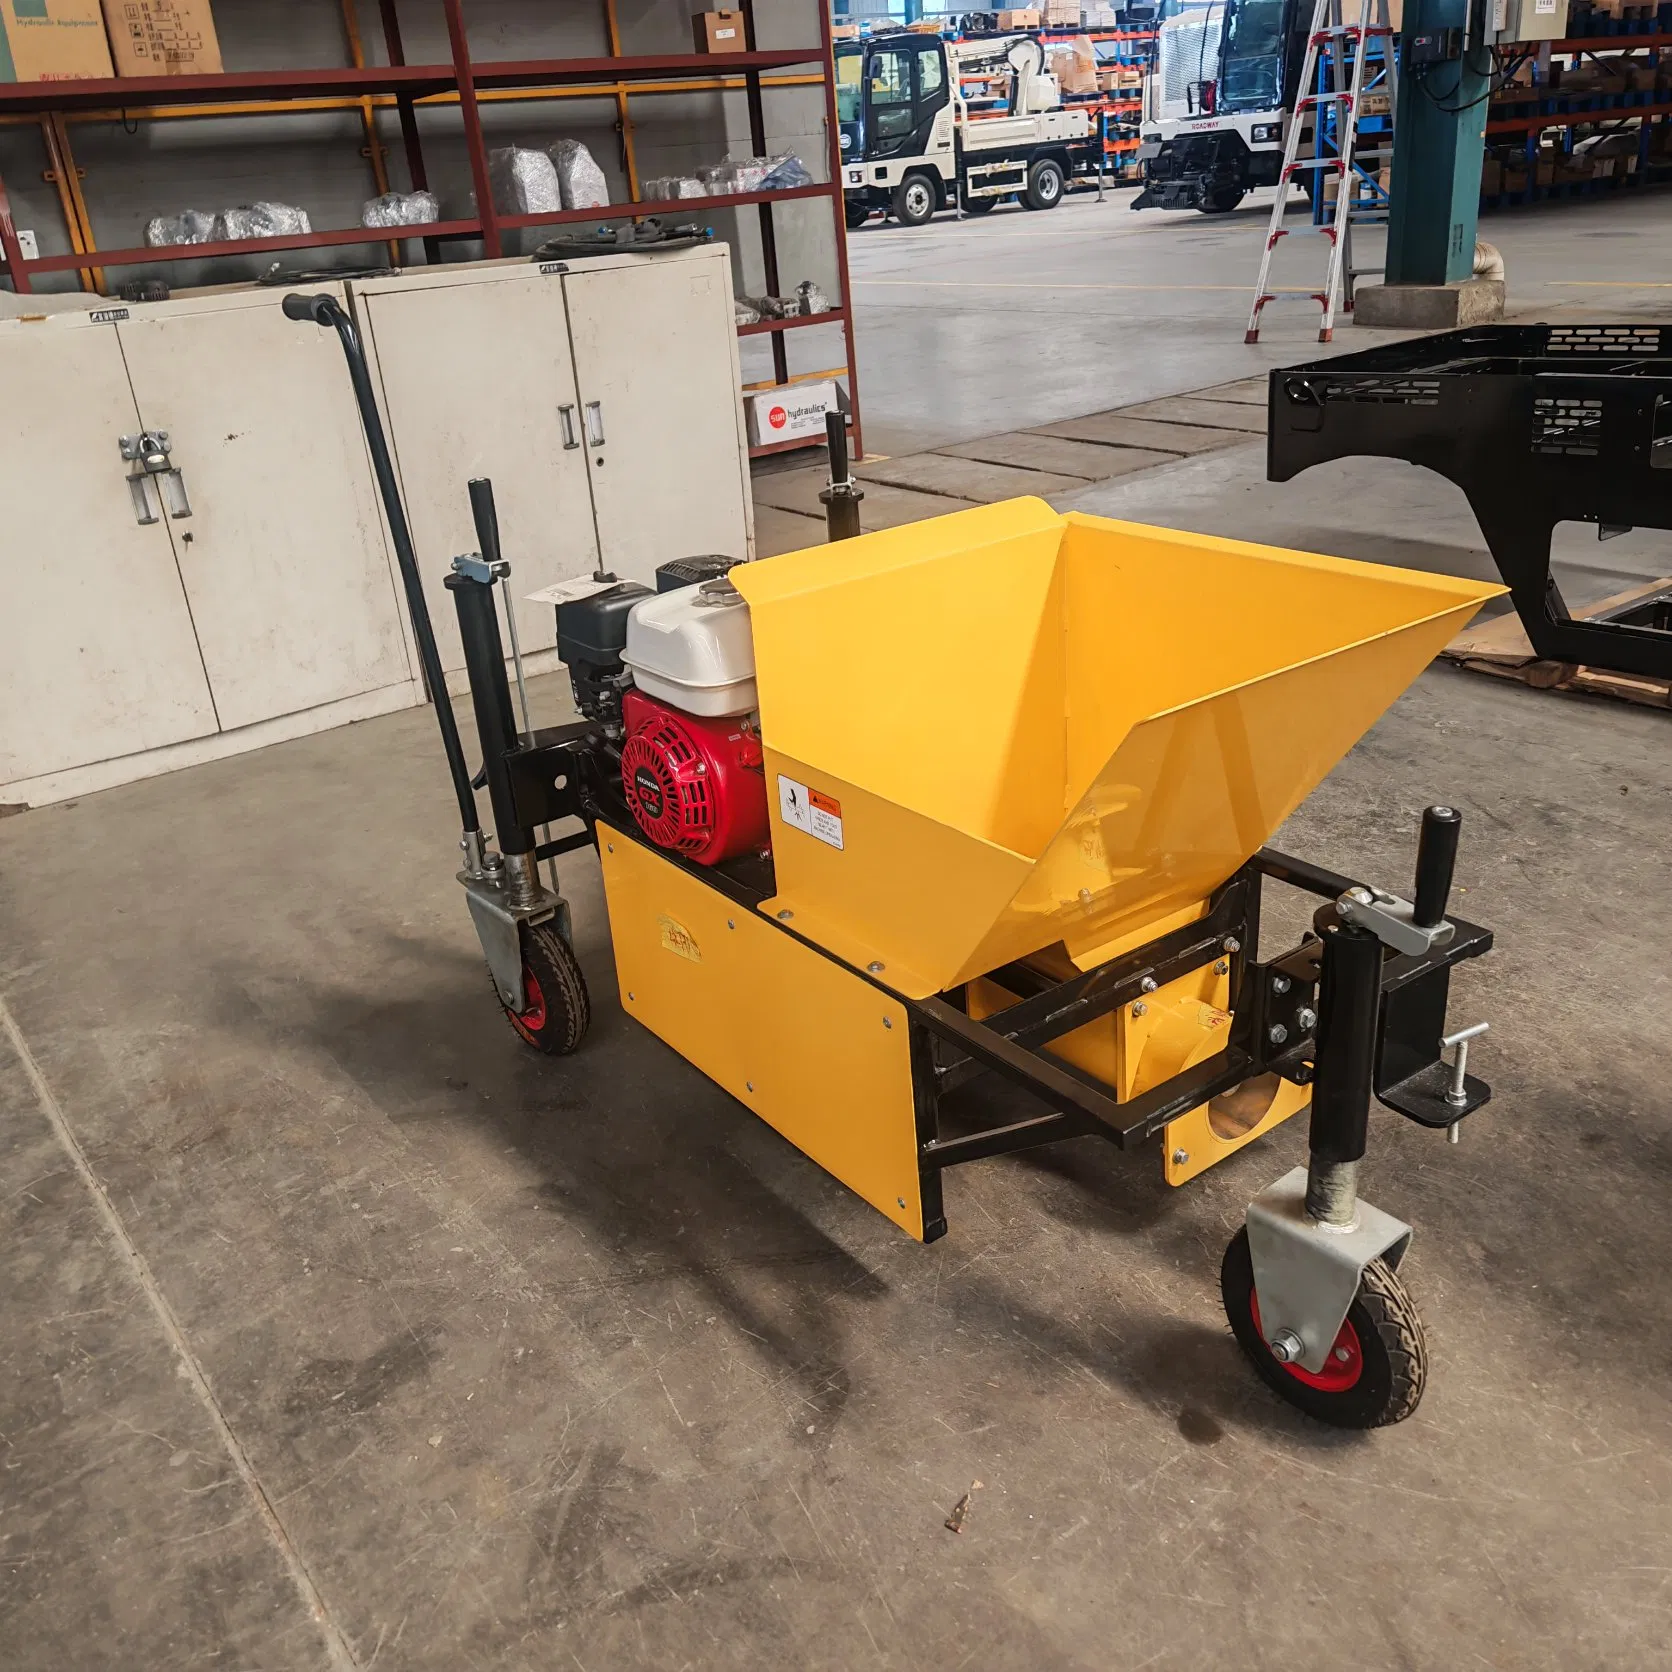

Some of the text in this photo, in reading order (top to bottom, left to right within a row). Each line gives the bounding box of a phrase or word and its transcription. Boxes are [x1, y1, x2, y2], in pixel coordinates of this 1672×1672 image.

[1191, 121, 1219, 130] ROADWAY
[788, 403, 826, 420] hydraulics
[636, 775, 660, 791] HONDA
[638, 786, 660, 807] GX
